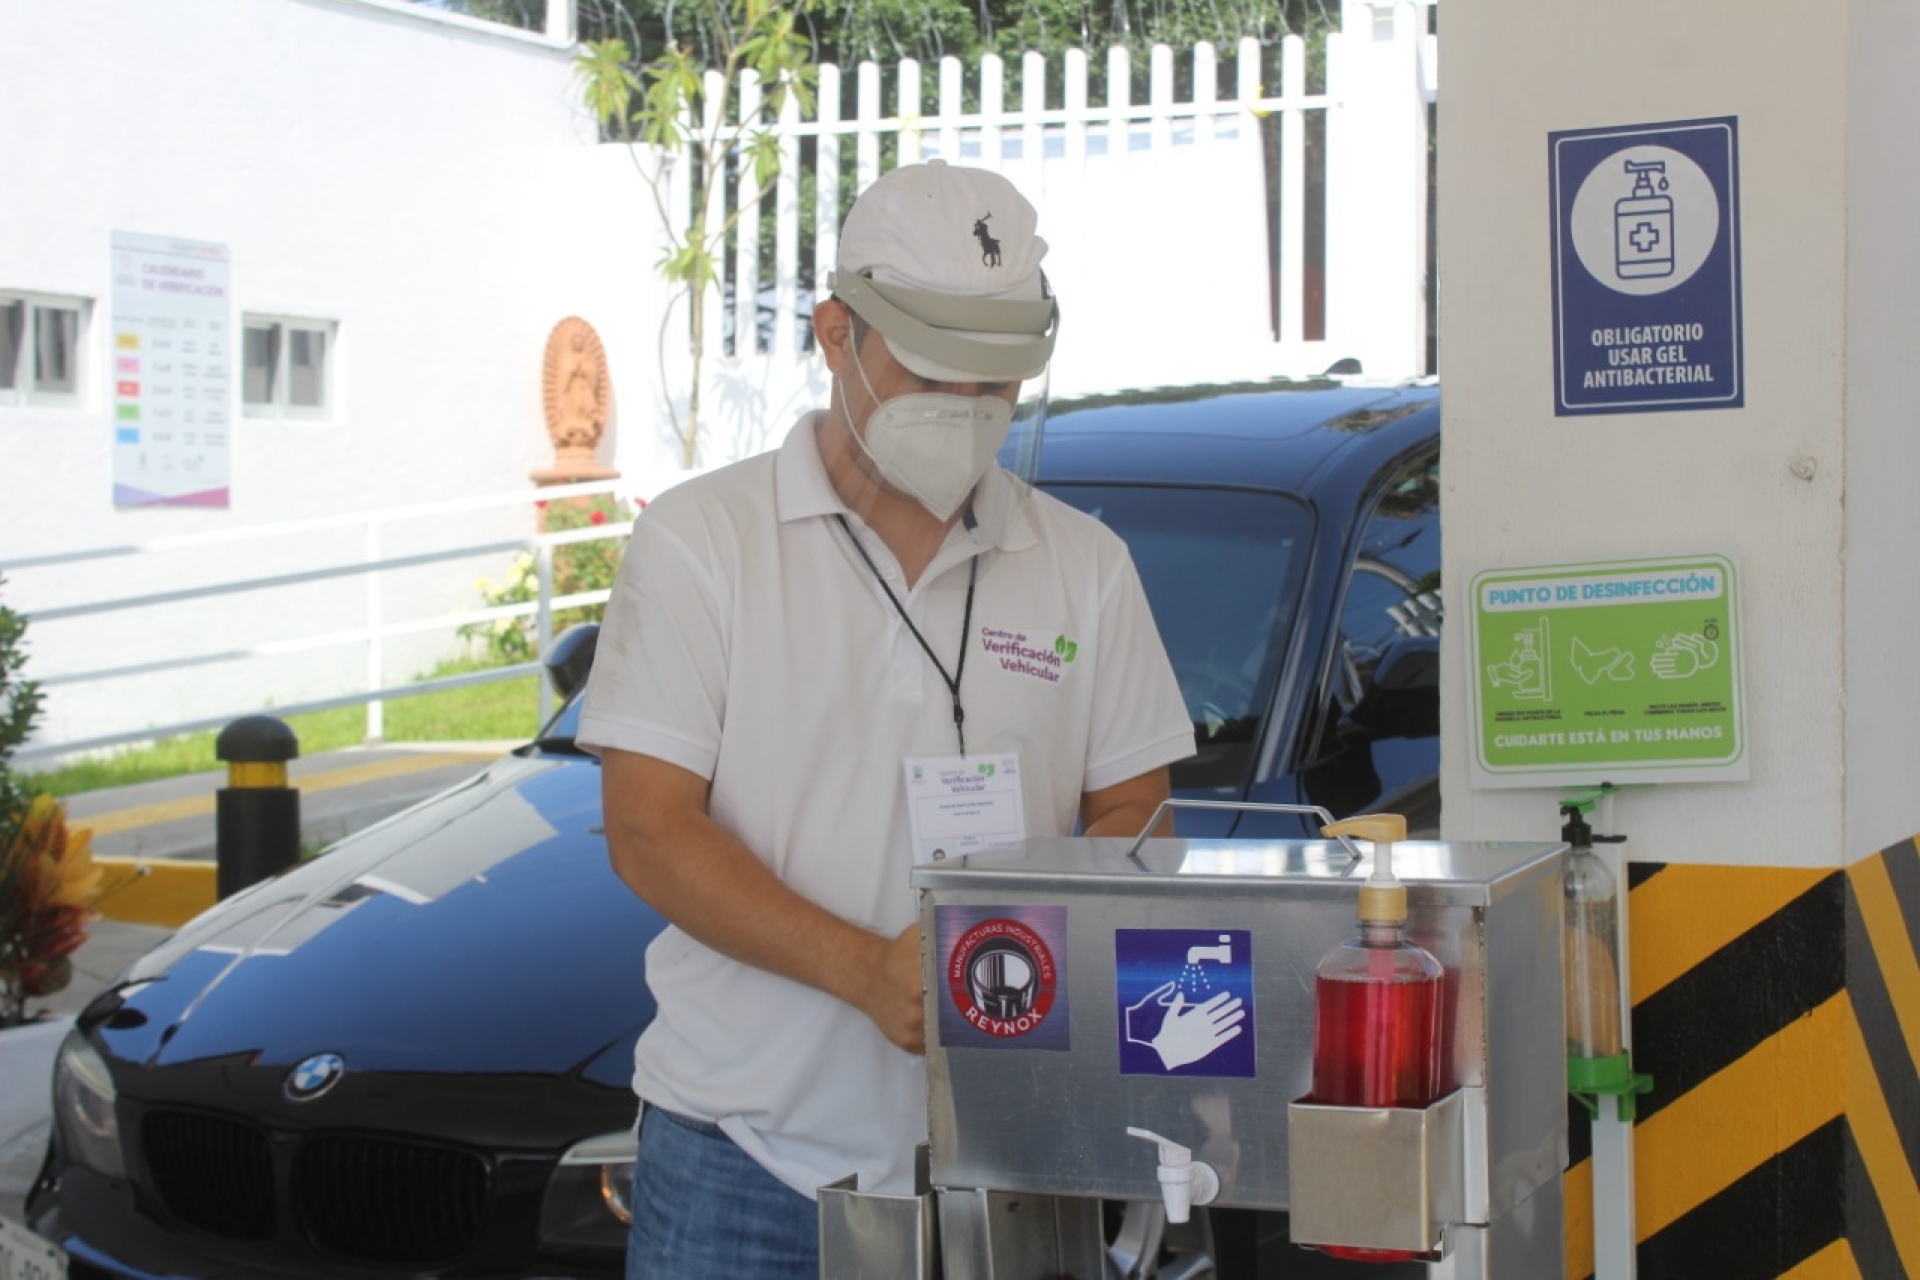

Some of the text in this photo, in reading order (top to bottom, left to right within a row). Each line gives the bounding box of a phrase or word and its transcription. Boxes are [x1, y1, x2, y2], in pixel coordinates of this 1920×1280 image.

[1592, 323, 1704, 347] OBLIGATORIO
[1608, 344, 1687, 366] USAR GEL
[1583, 364, 1714, 388] ANTIBACTERIAL
[1489, 572, 1715, 605] PUNTO DE DESINFECCIÓN
[982, 627, 1027, 642] Centro de
[982, 639, 1061, 667] Verificación
[1000, 657, 1060, 682] Vehicular
[1495, 725, 1723, 748] CUIDARTE ESTÁ EN TUS MANOS
[953, 924, 1052, 979] MANUFACTURAS INDUSTRIALES
[965, 1006, 1042, 1034] REYNOX
